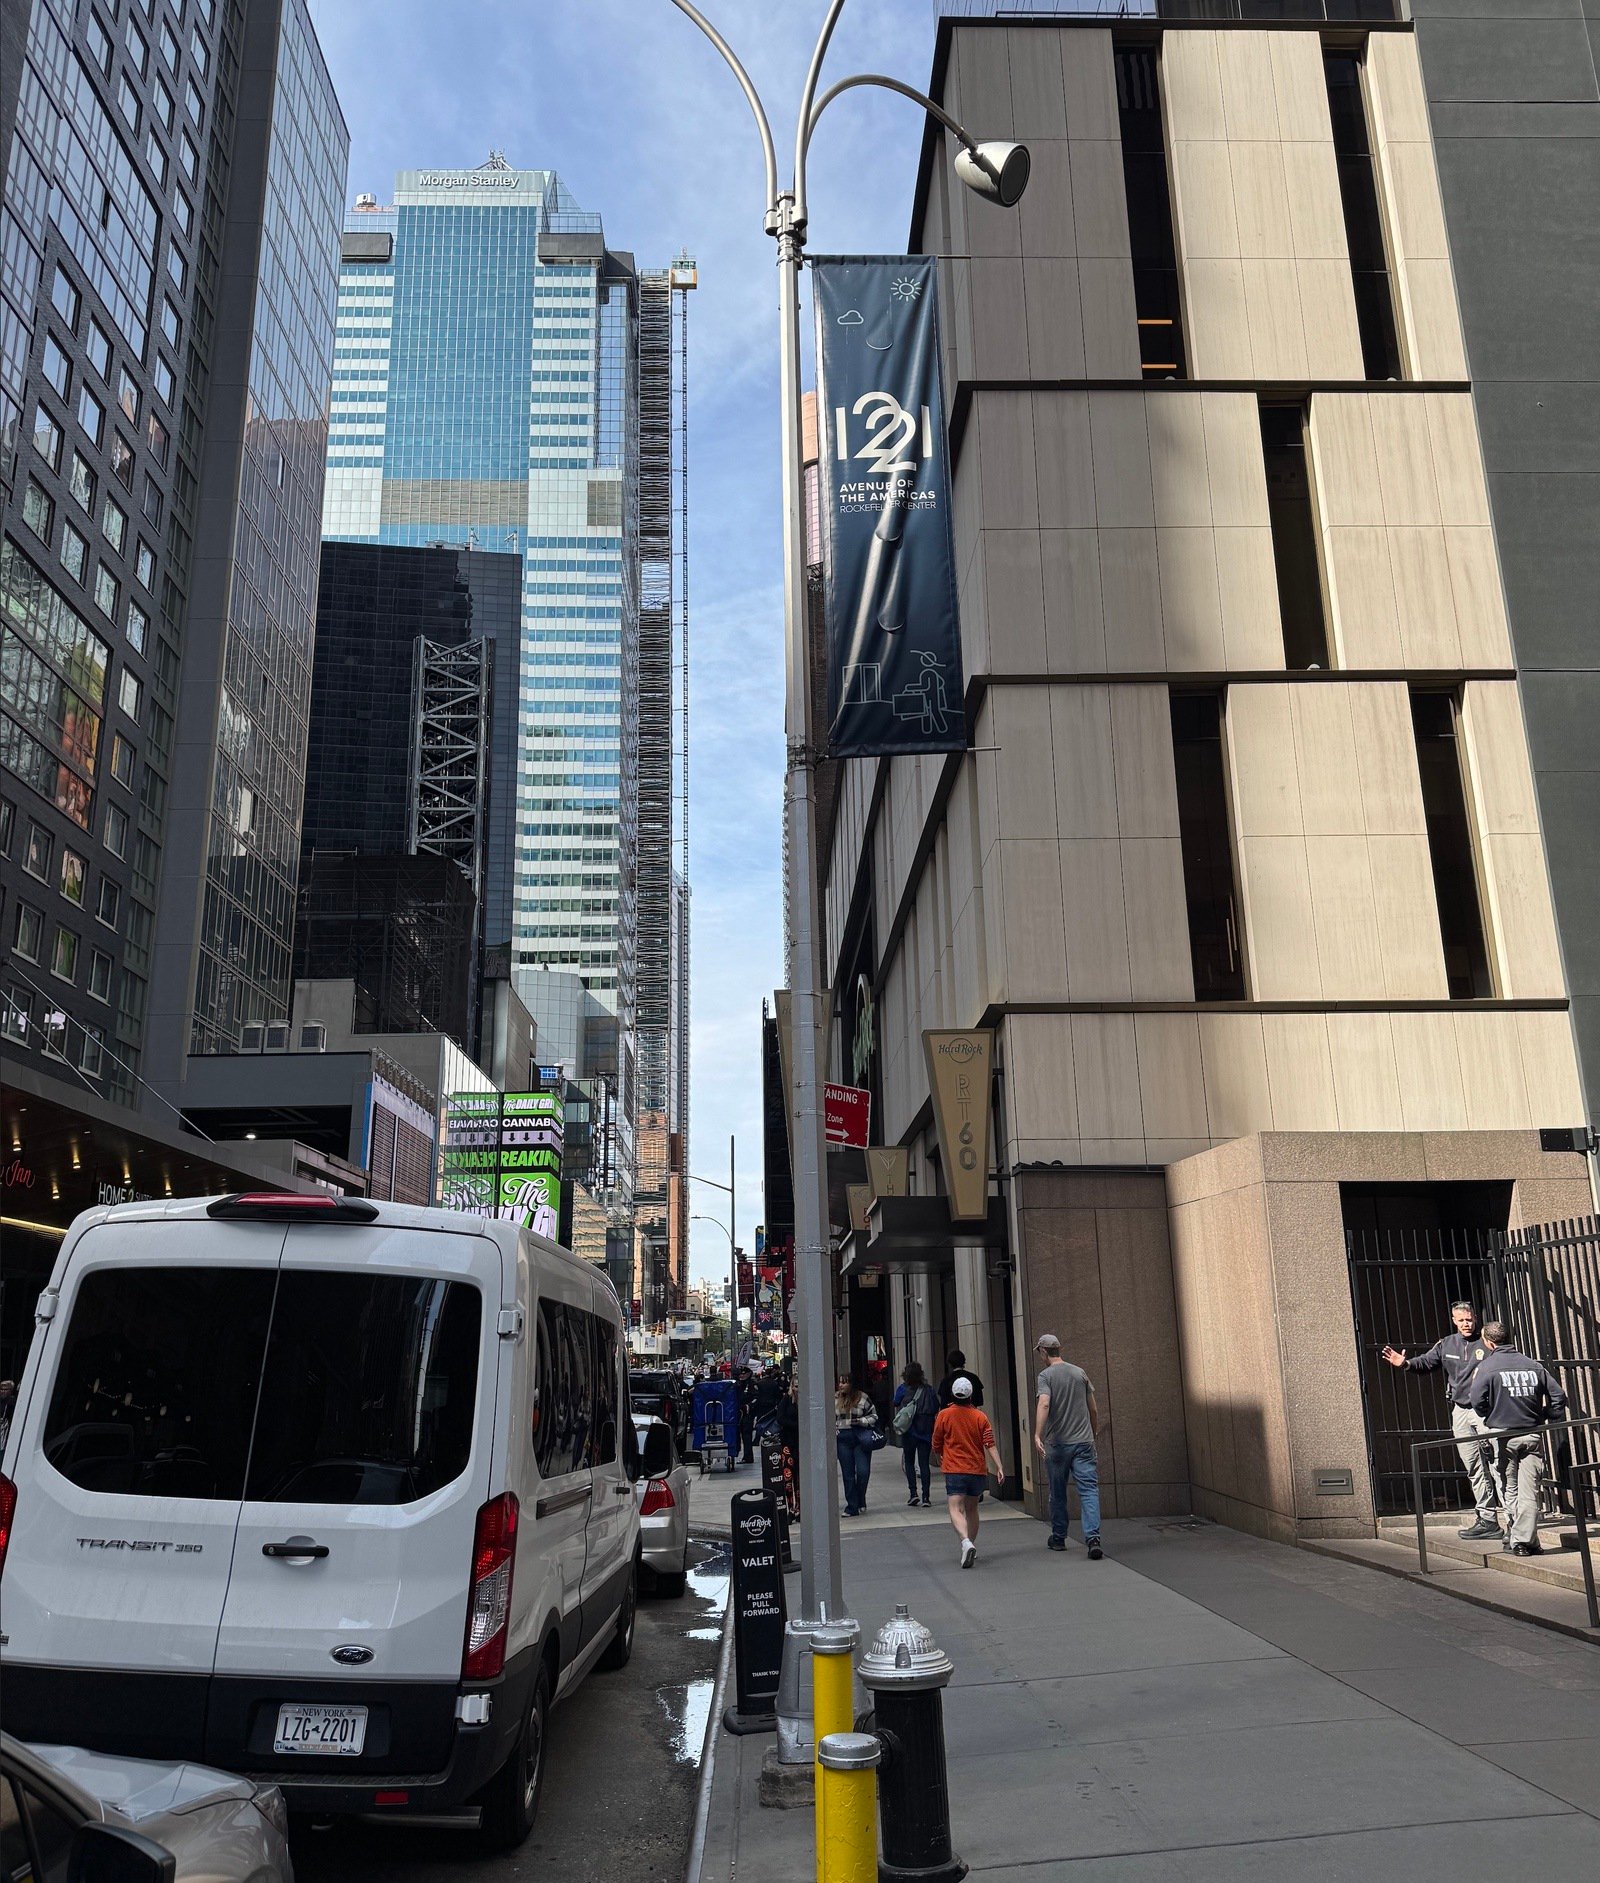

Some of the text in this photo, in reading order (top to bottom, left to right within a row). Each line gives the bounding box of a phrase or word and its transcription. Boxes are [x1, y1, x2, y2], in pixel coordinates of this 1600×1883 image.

[420, 175, 519, 188] Morgan Stanley
[840, 479, 914, 493] AVENUE OF
[840, 489, 936, 503] THE AMERICAS
[840, 500, 937, 513] ROCKEFELER CENTER
[938, 1044, 983, 1056] Hard Rock
[824, 1088, 858, 1105] ANDING
[515, 1099, 540, 1109] DAILY
[502, 1117, 551, 1128] CANNAB
[826, 1113, 844, 1124] Zone
[6, 1160, 36, 1188] Inn
[98, 1182, 127, 1206] HOME
[503, 1177, 550, 1212] The
[1499, 1370, 1539, 1388] NYPD
[1508, 1386, 1535, 1397] TARU
[740, 1518, 772, 1528] Hard Rock
[76, 1538, 203, 1553] TRANSIT 350
[741, 1555, 775, 1567] VALET
[747, 1592, 774, 1601] PLEASE
[752, 1600, 770, 1608] PULL
[743, 1607, 780, 1617] FORWARD
[302, 1708, 347, 1717] NEW YORK
[281, 1717, 357, 1743] LZG 2201
